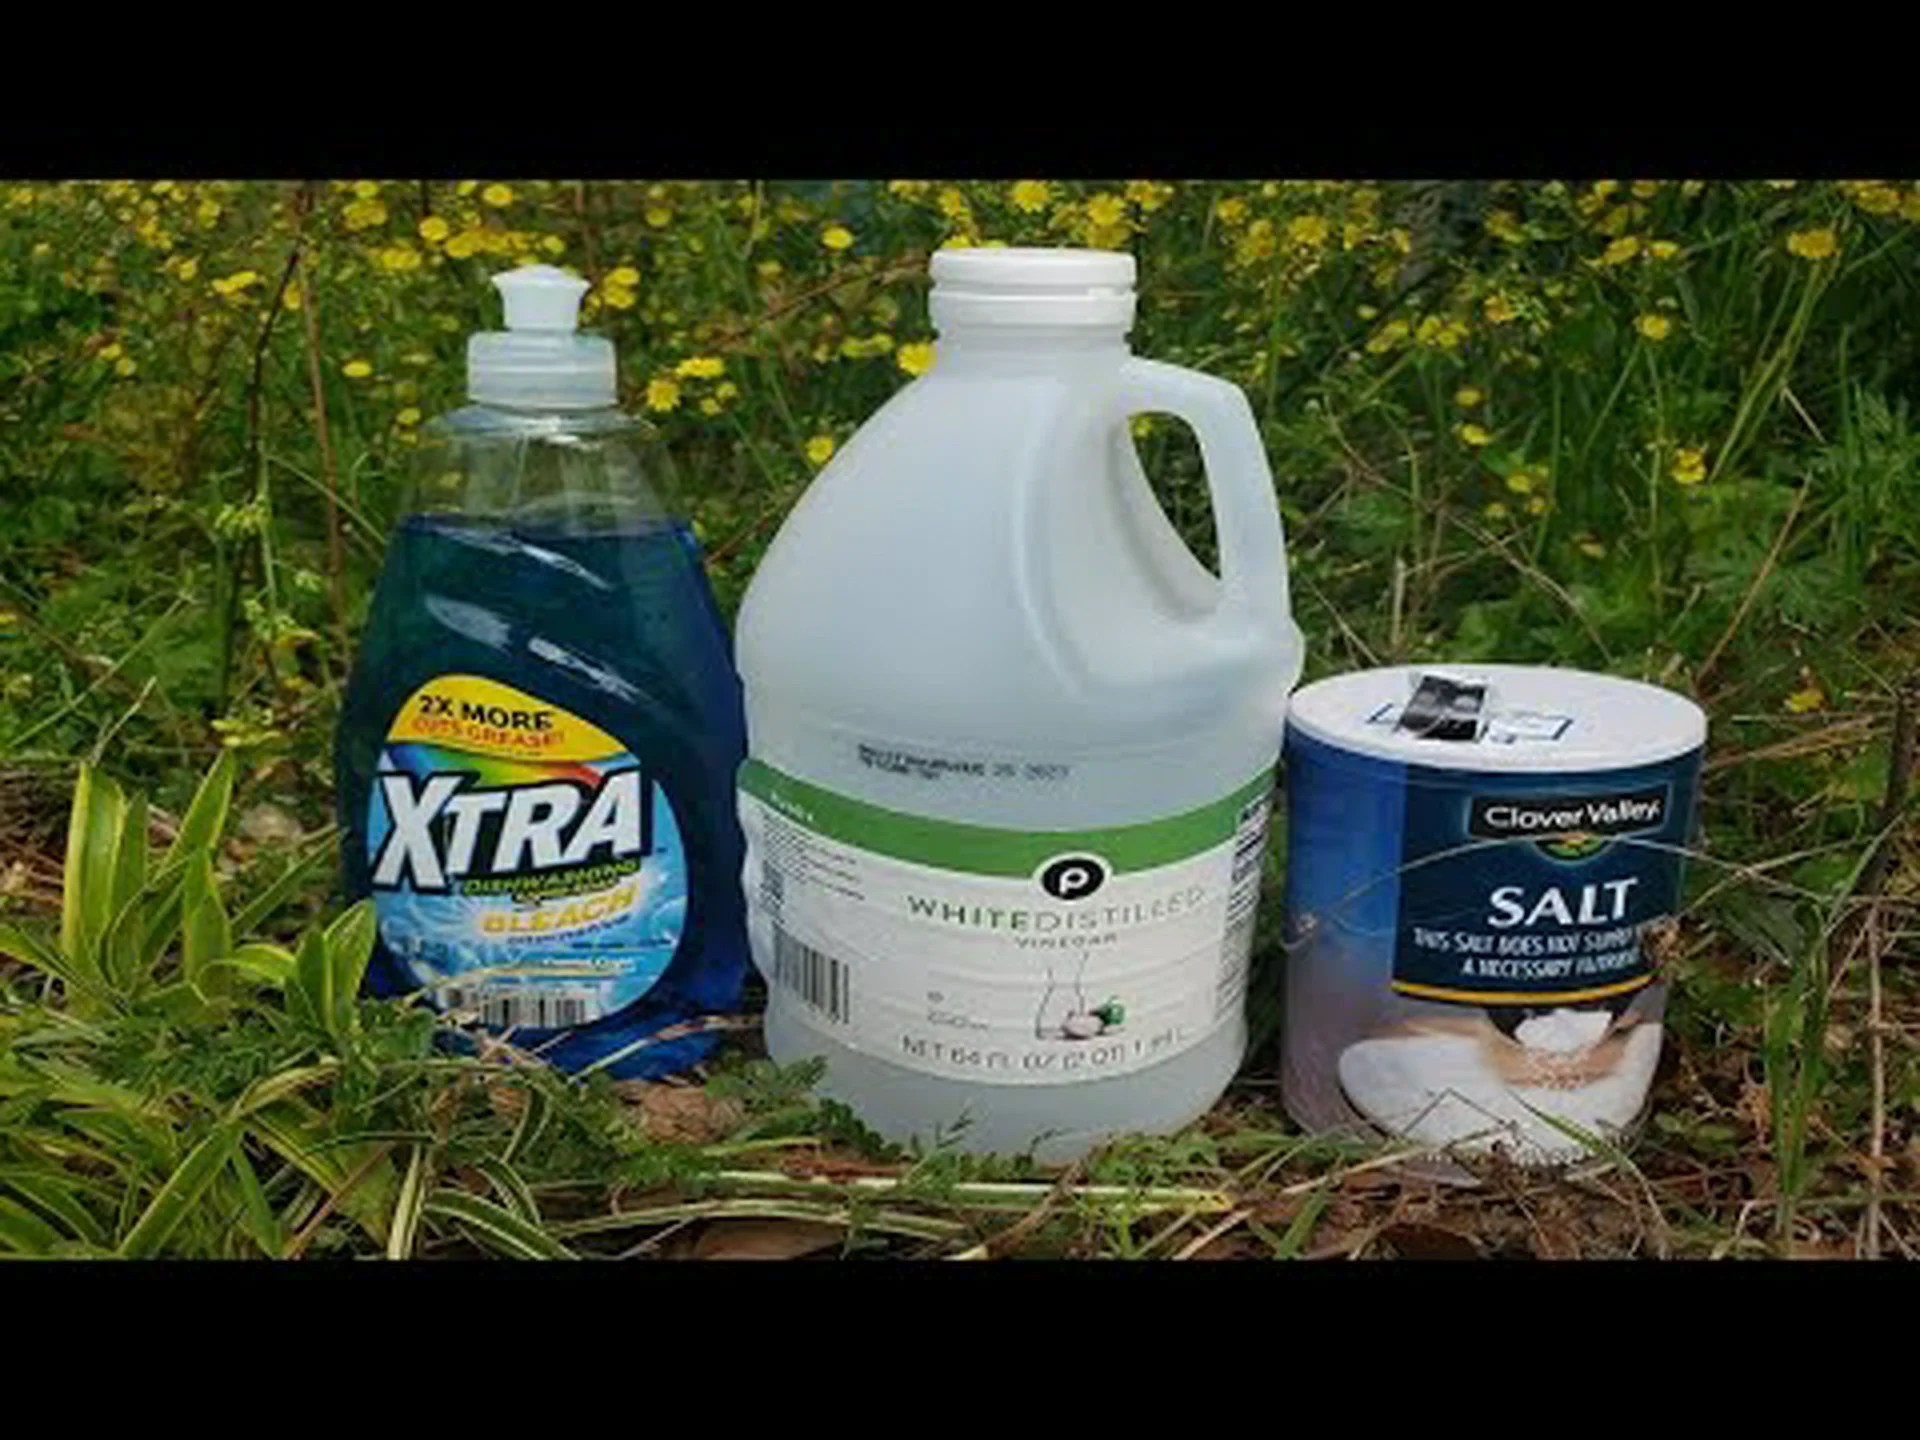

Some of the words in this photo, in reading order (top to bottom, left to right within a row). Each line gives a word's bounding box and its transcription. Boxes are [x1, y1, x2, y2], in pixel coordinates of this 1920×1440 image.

[419, 695, 454, 718] 2X
[461, 702, 555, 731] MORE
[372, 770, 642, 888] XTRA
[1485, 805, 1584, 830] Clover
[1487, 877, 1639, 929] SALT
[1014, 932, 1118, 950] VINEGAR
